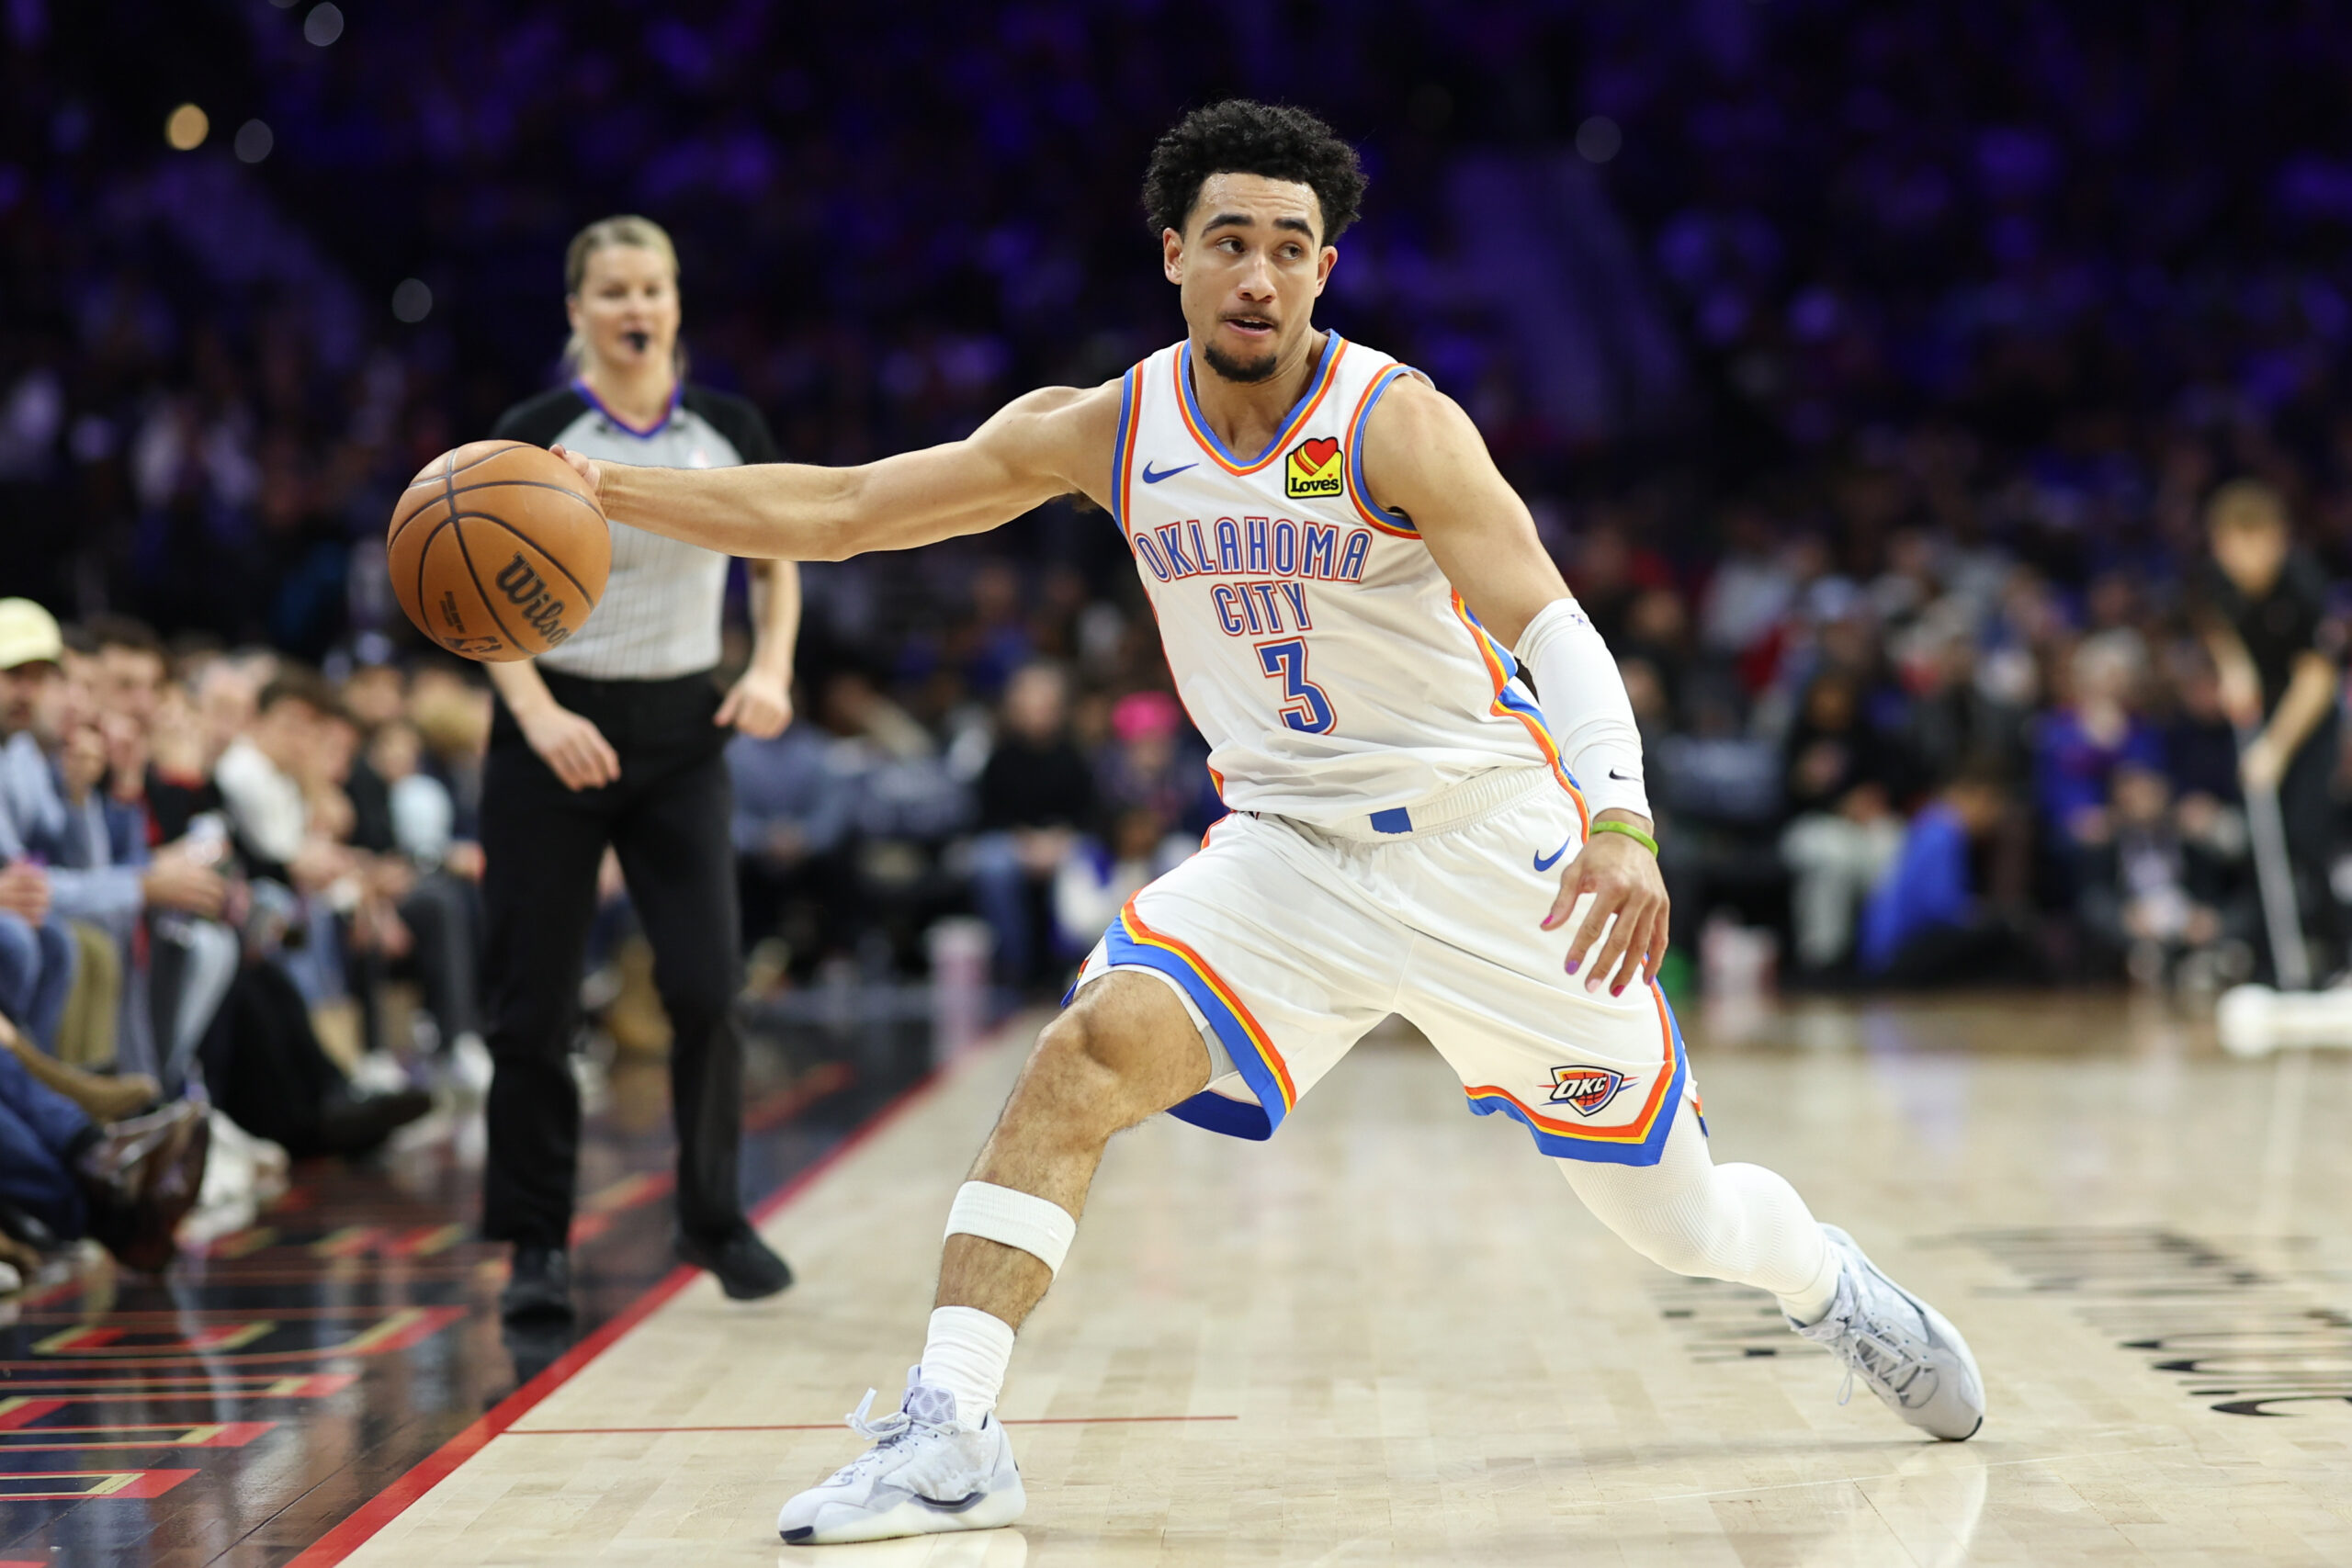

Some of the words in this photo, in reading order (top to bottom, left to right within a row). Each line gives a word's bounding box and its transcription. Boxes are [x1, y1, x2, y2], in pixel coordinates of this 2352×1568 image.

[1134, 516, 1374, 583] OKLAHOMA
[1210, 580, 1313, 637] CITY
[1253, 636, 1338, 736] 3
[1551, 1076, 1609, 1100] OKC
